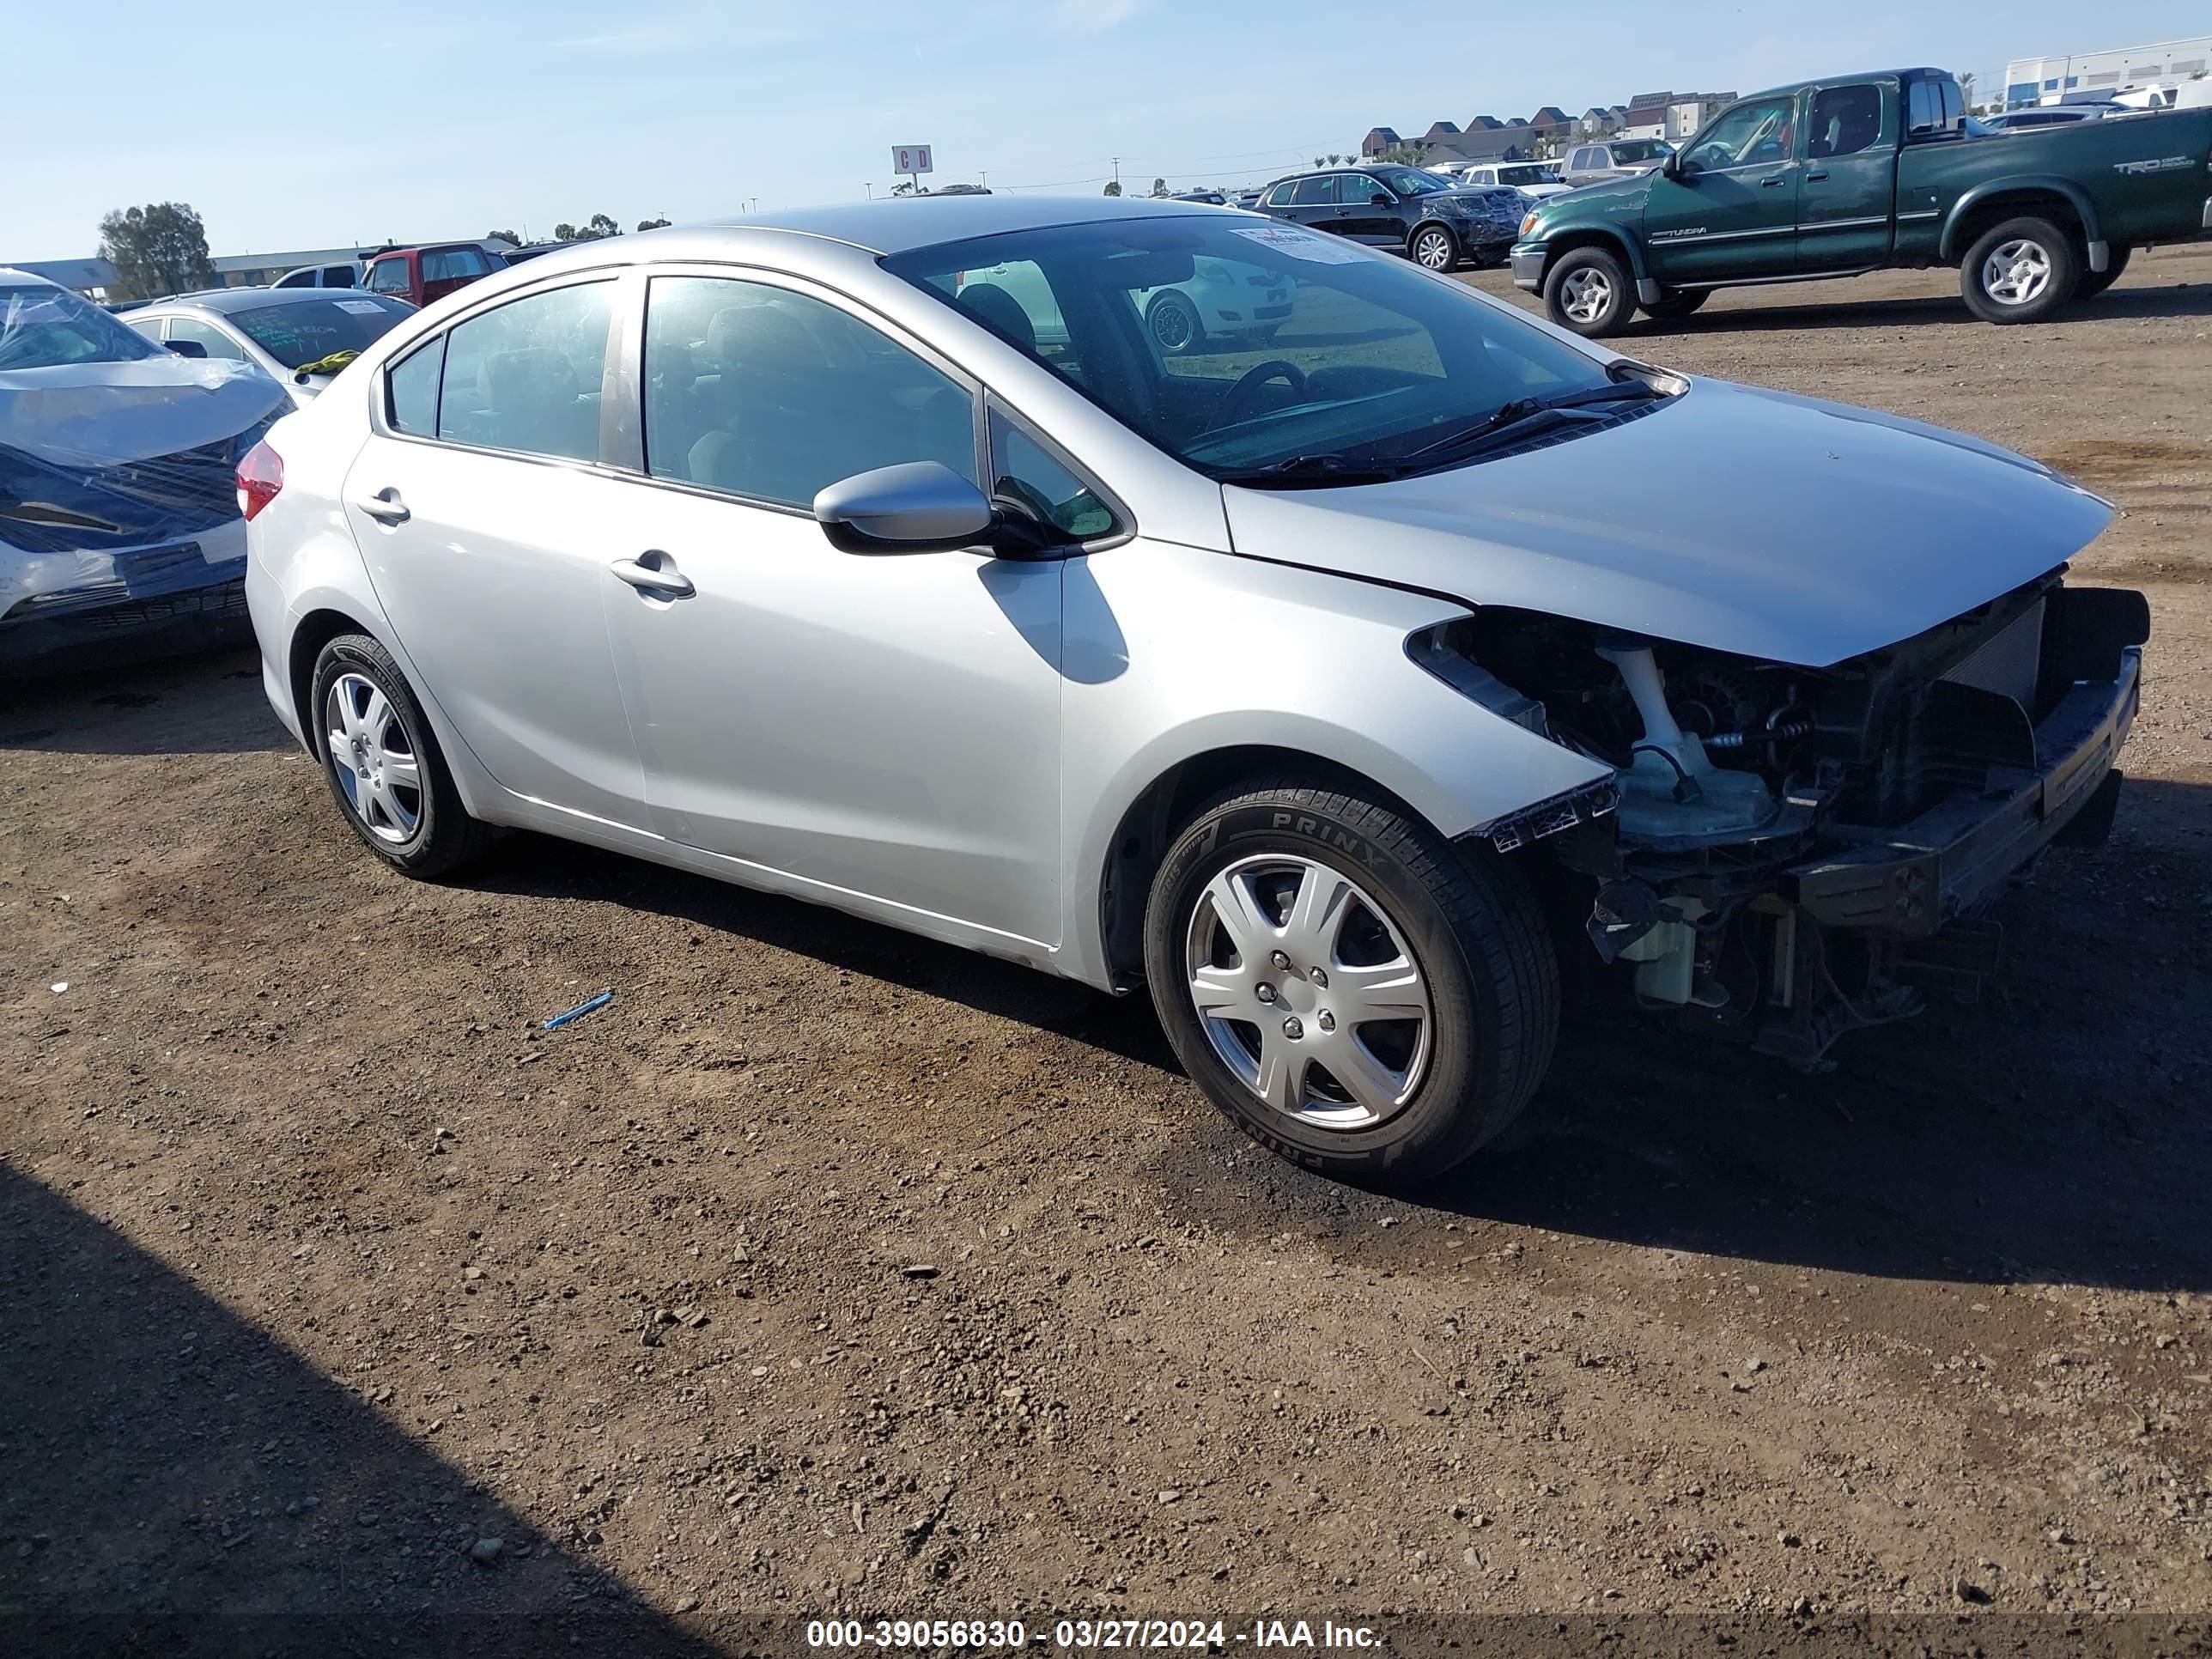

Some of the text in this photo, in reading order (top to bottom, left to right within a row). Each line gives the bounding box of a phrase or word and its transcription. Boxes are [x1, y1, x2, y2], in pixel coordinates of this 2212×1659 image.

[900, 149, 927, 169] C D
[2113, 160, 2161, 174] TRD
[1669, 227, 1707, 237] TUNDRA
[1272, 812, 1389, 868] PRINX
